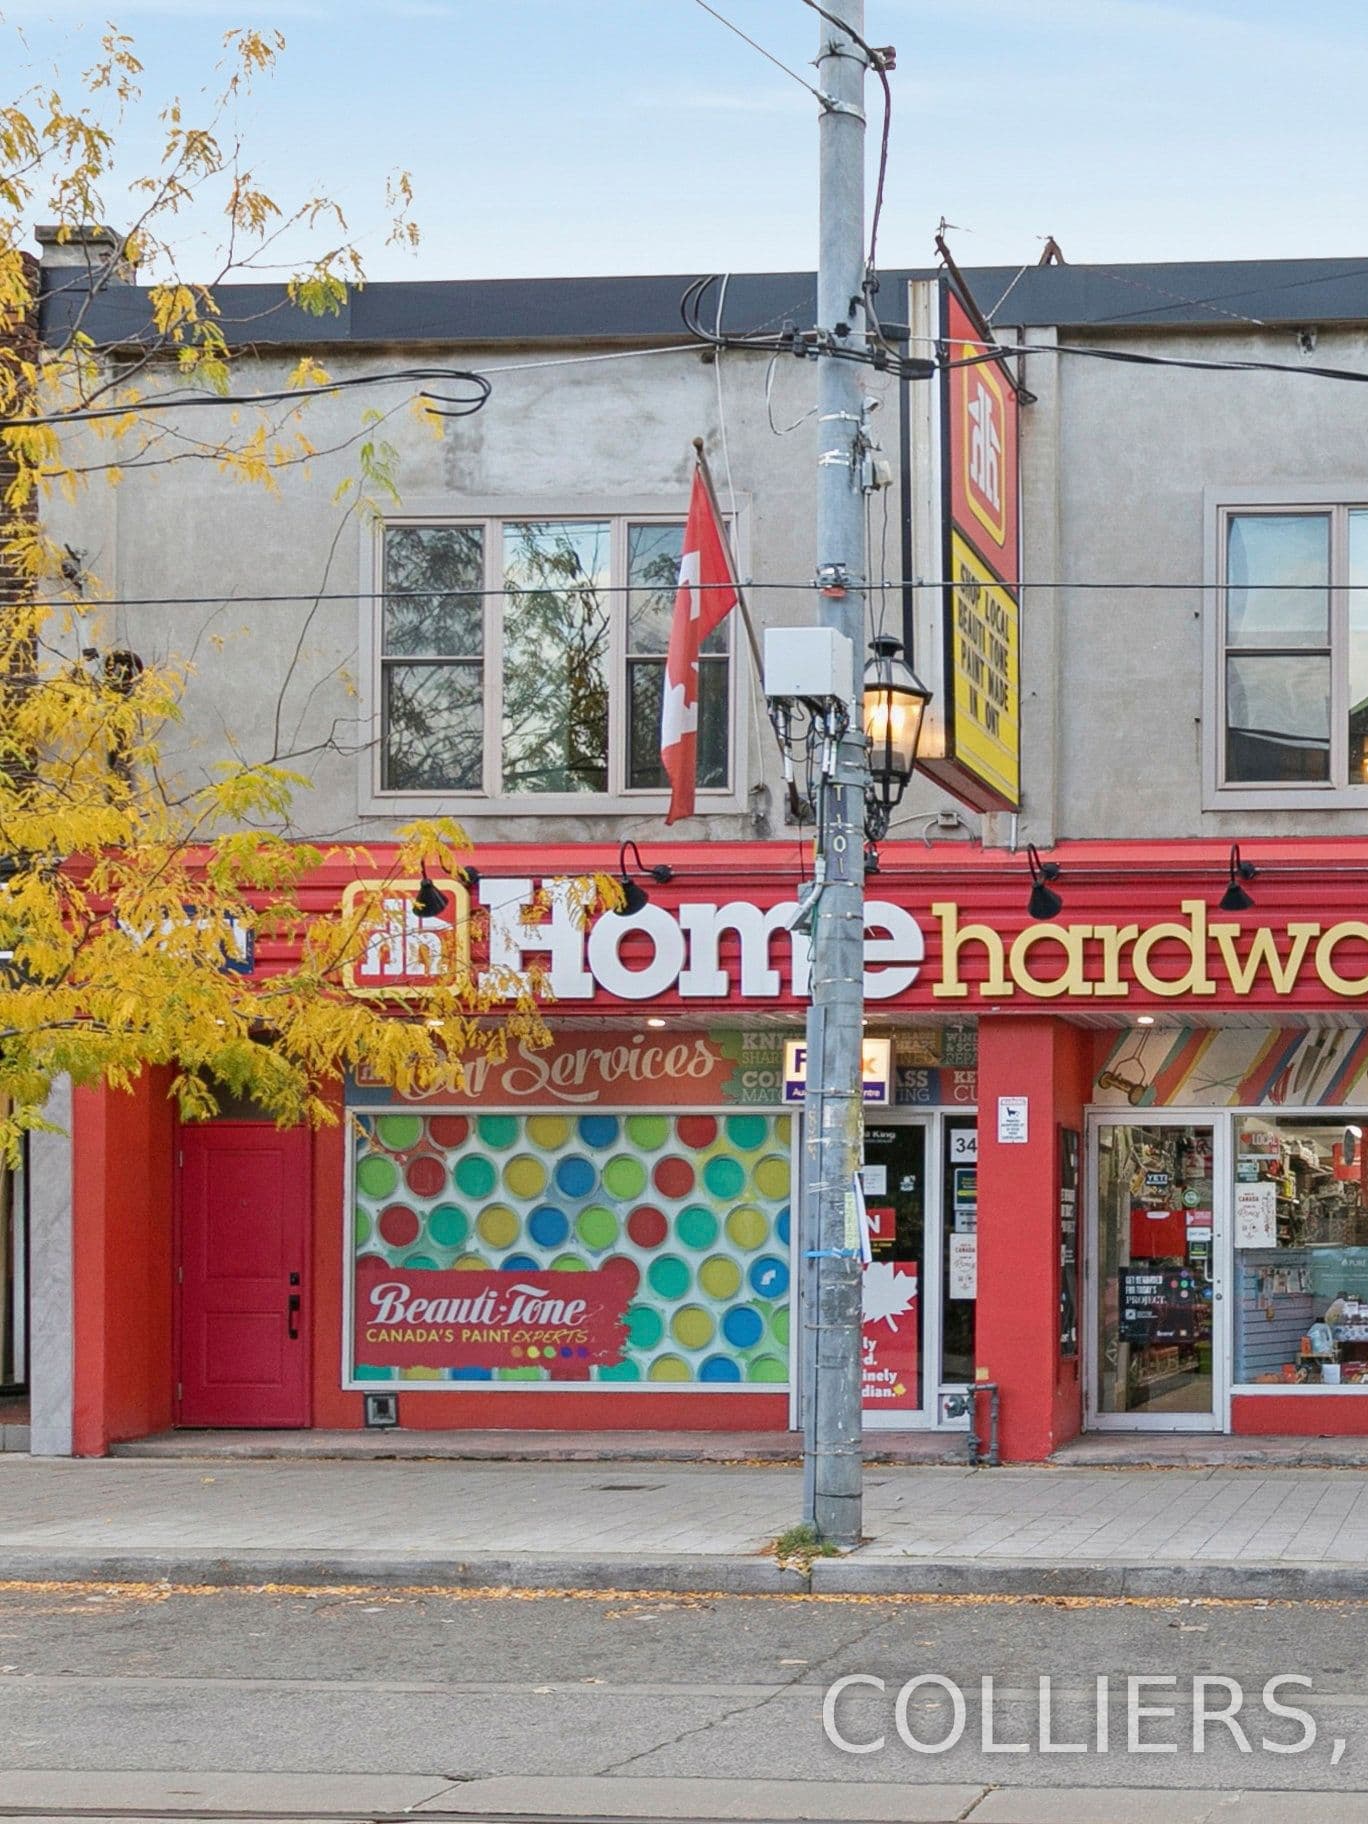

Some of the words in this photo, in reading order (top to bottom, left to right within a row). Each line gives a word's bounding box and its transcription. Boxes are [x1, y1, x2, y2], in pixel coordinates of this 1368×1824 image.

[985, 590, 1009, 644] LOCAL
[961, 638, 984, 688] PAINT
[988, 665, 1010, 712] MADE
[969, 685, 978, 718] IN
[985, 701, 1000, 738] ONT
[478, 877, 925, 1000] Home
[502, 1034, 721, 1102] Services
[1147, 1173, 1168, 1181] YETI
[366, 1328, 454, 1343] CANADA'S
[462, 1329, 510, 1343] PAINT
[511, 1329, 588, 1344] EXPERTS
